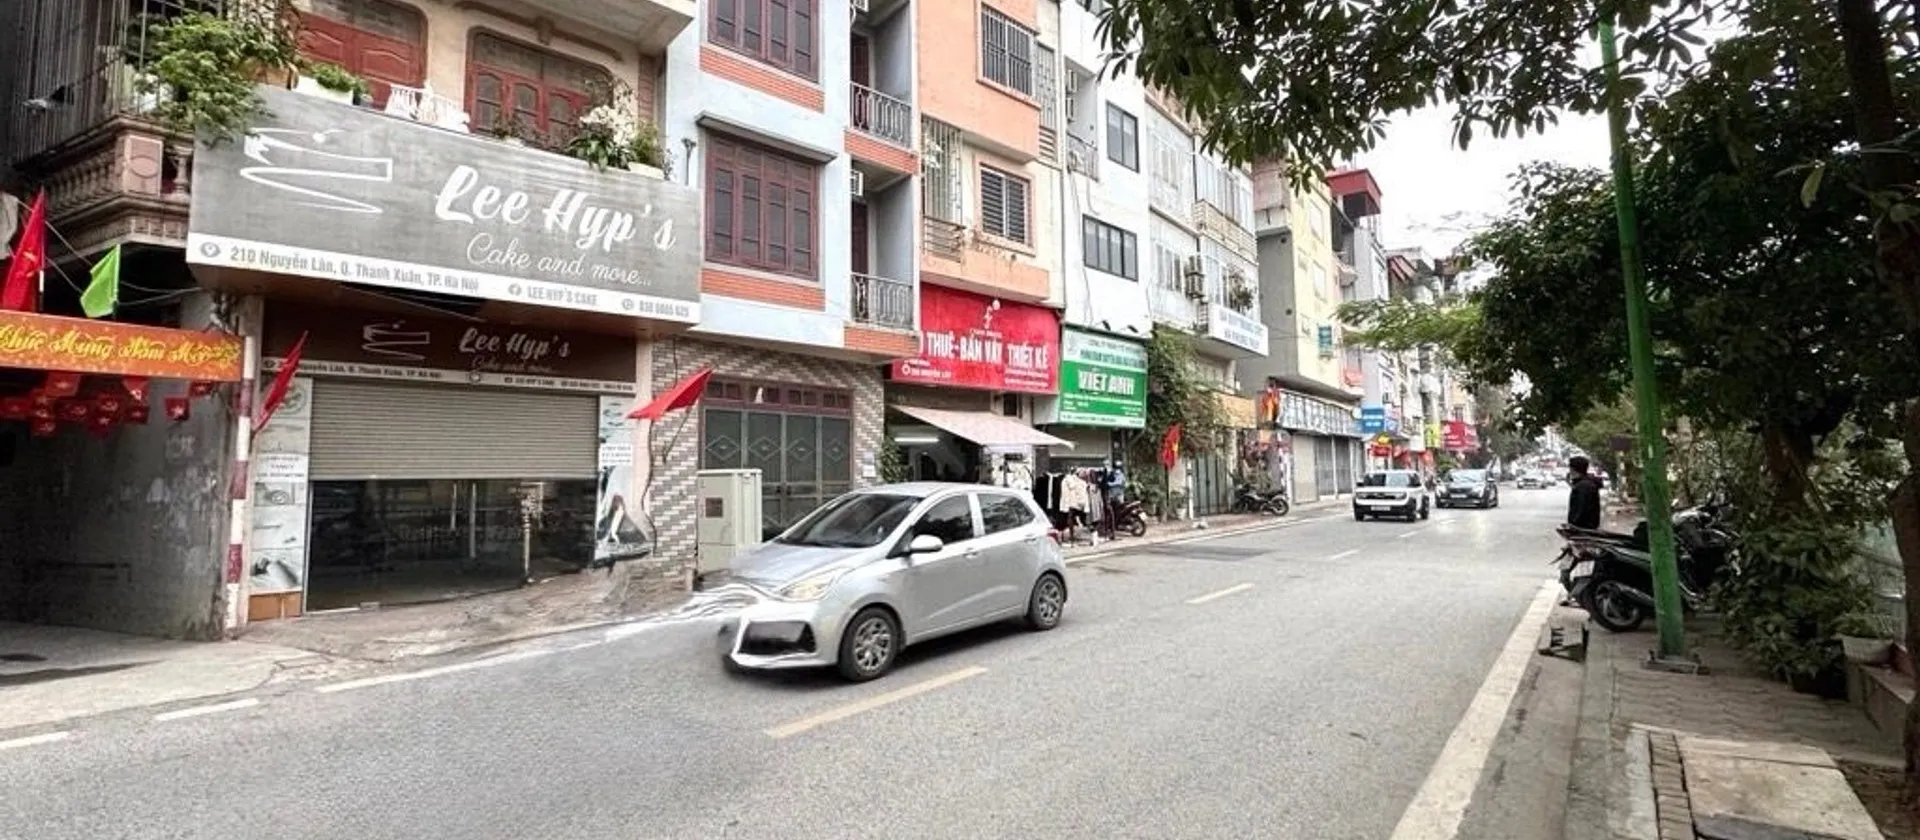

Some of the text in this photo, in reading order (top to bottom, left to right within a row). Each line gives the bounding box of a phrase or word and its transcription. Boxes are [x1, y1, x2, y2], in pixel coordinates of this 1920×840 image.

[435, 164, 677, 252] Lee Hyp's
[230, 246, 257, 263] 210
[259, 250, 309, 270] Nguyễn
[355, 263, 391, 282] Thanh
[466, 232, 532, 269] Cake
[537, 253, 585, 277] and
[527, 286, 545, 300] LEE
[459, 327, 571, 360] Lee Hyp's
[1077, 367, 1107, 395] VIỆT
[1107, 375, 1135, 396] ANH
